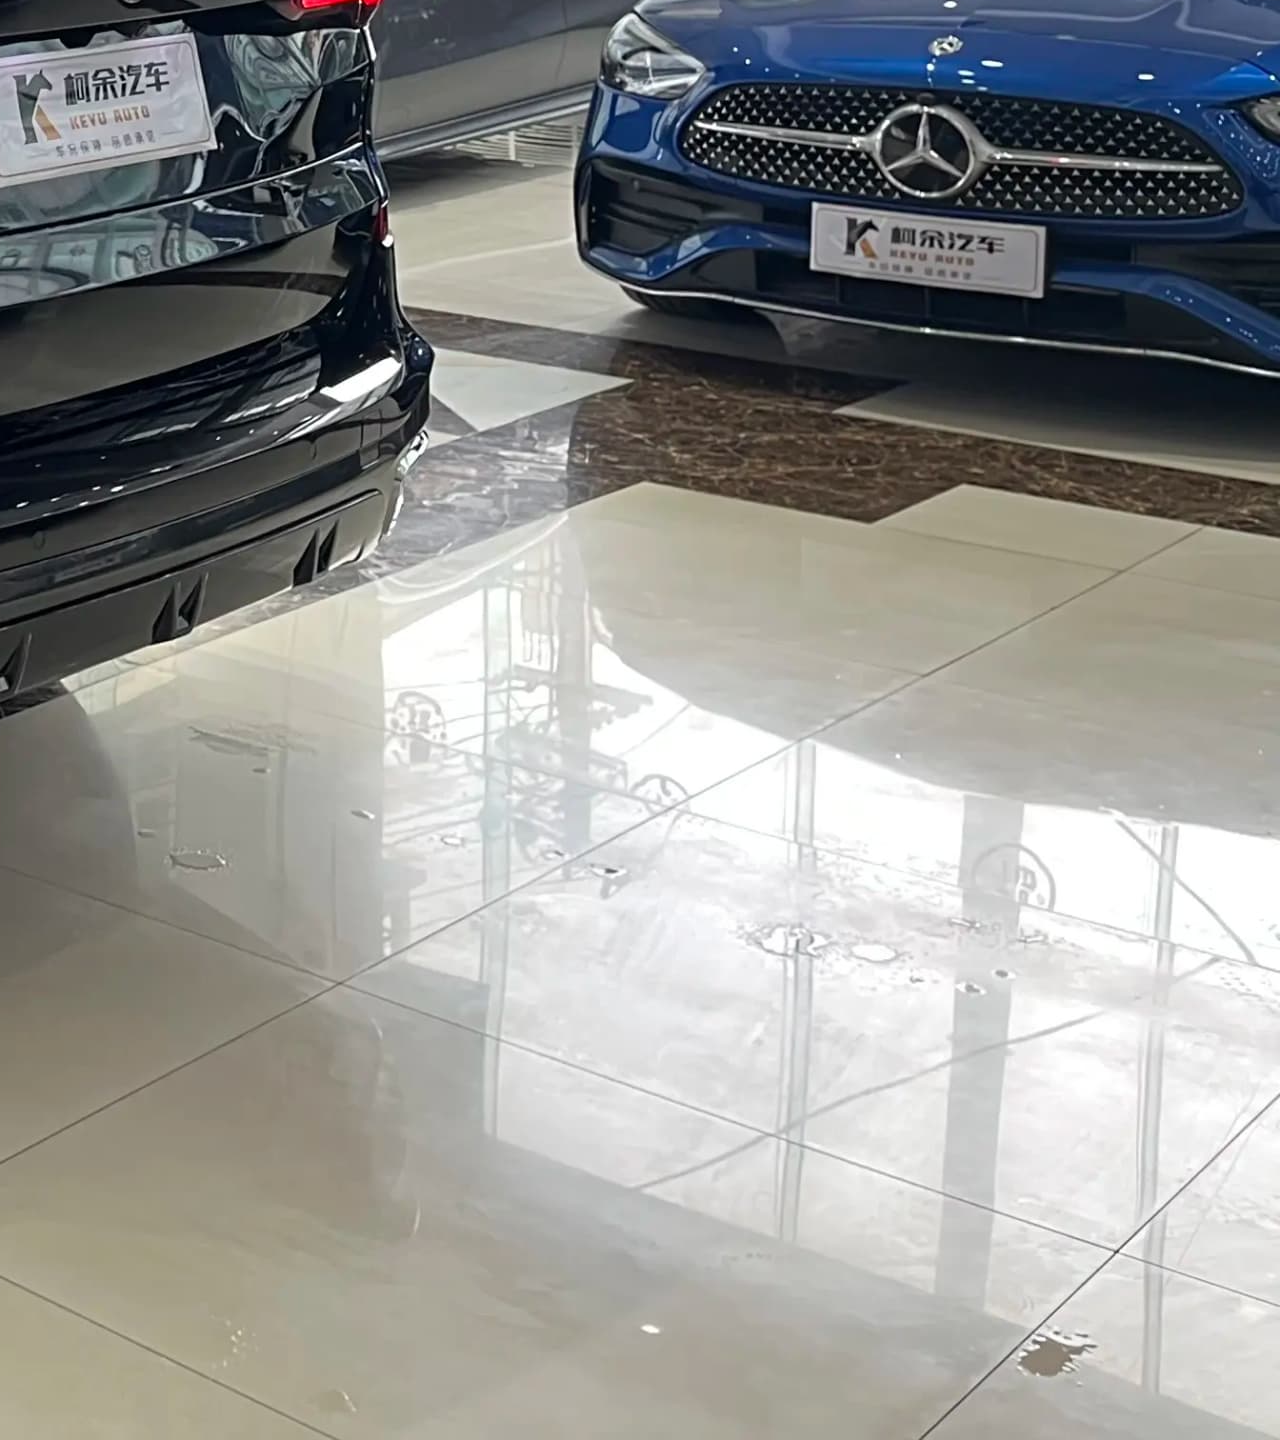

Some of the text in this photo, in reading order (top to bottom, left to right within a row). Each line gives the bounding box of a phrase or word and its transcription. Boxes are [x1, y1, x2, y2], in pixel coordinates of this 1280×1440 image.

[63, 61, 170, 106] 柯余汽车
[69, 105, 151, 130] KEYU AUTO
[890, 226, 1005, 254] 柯余汽车
